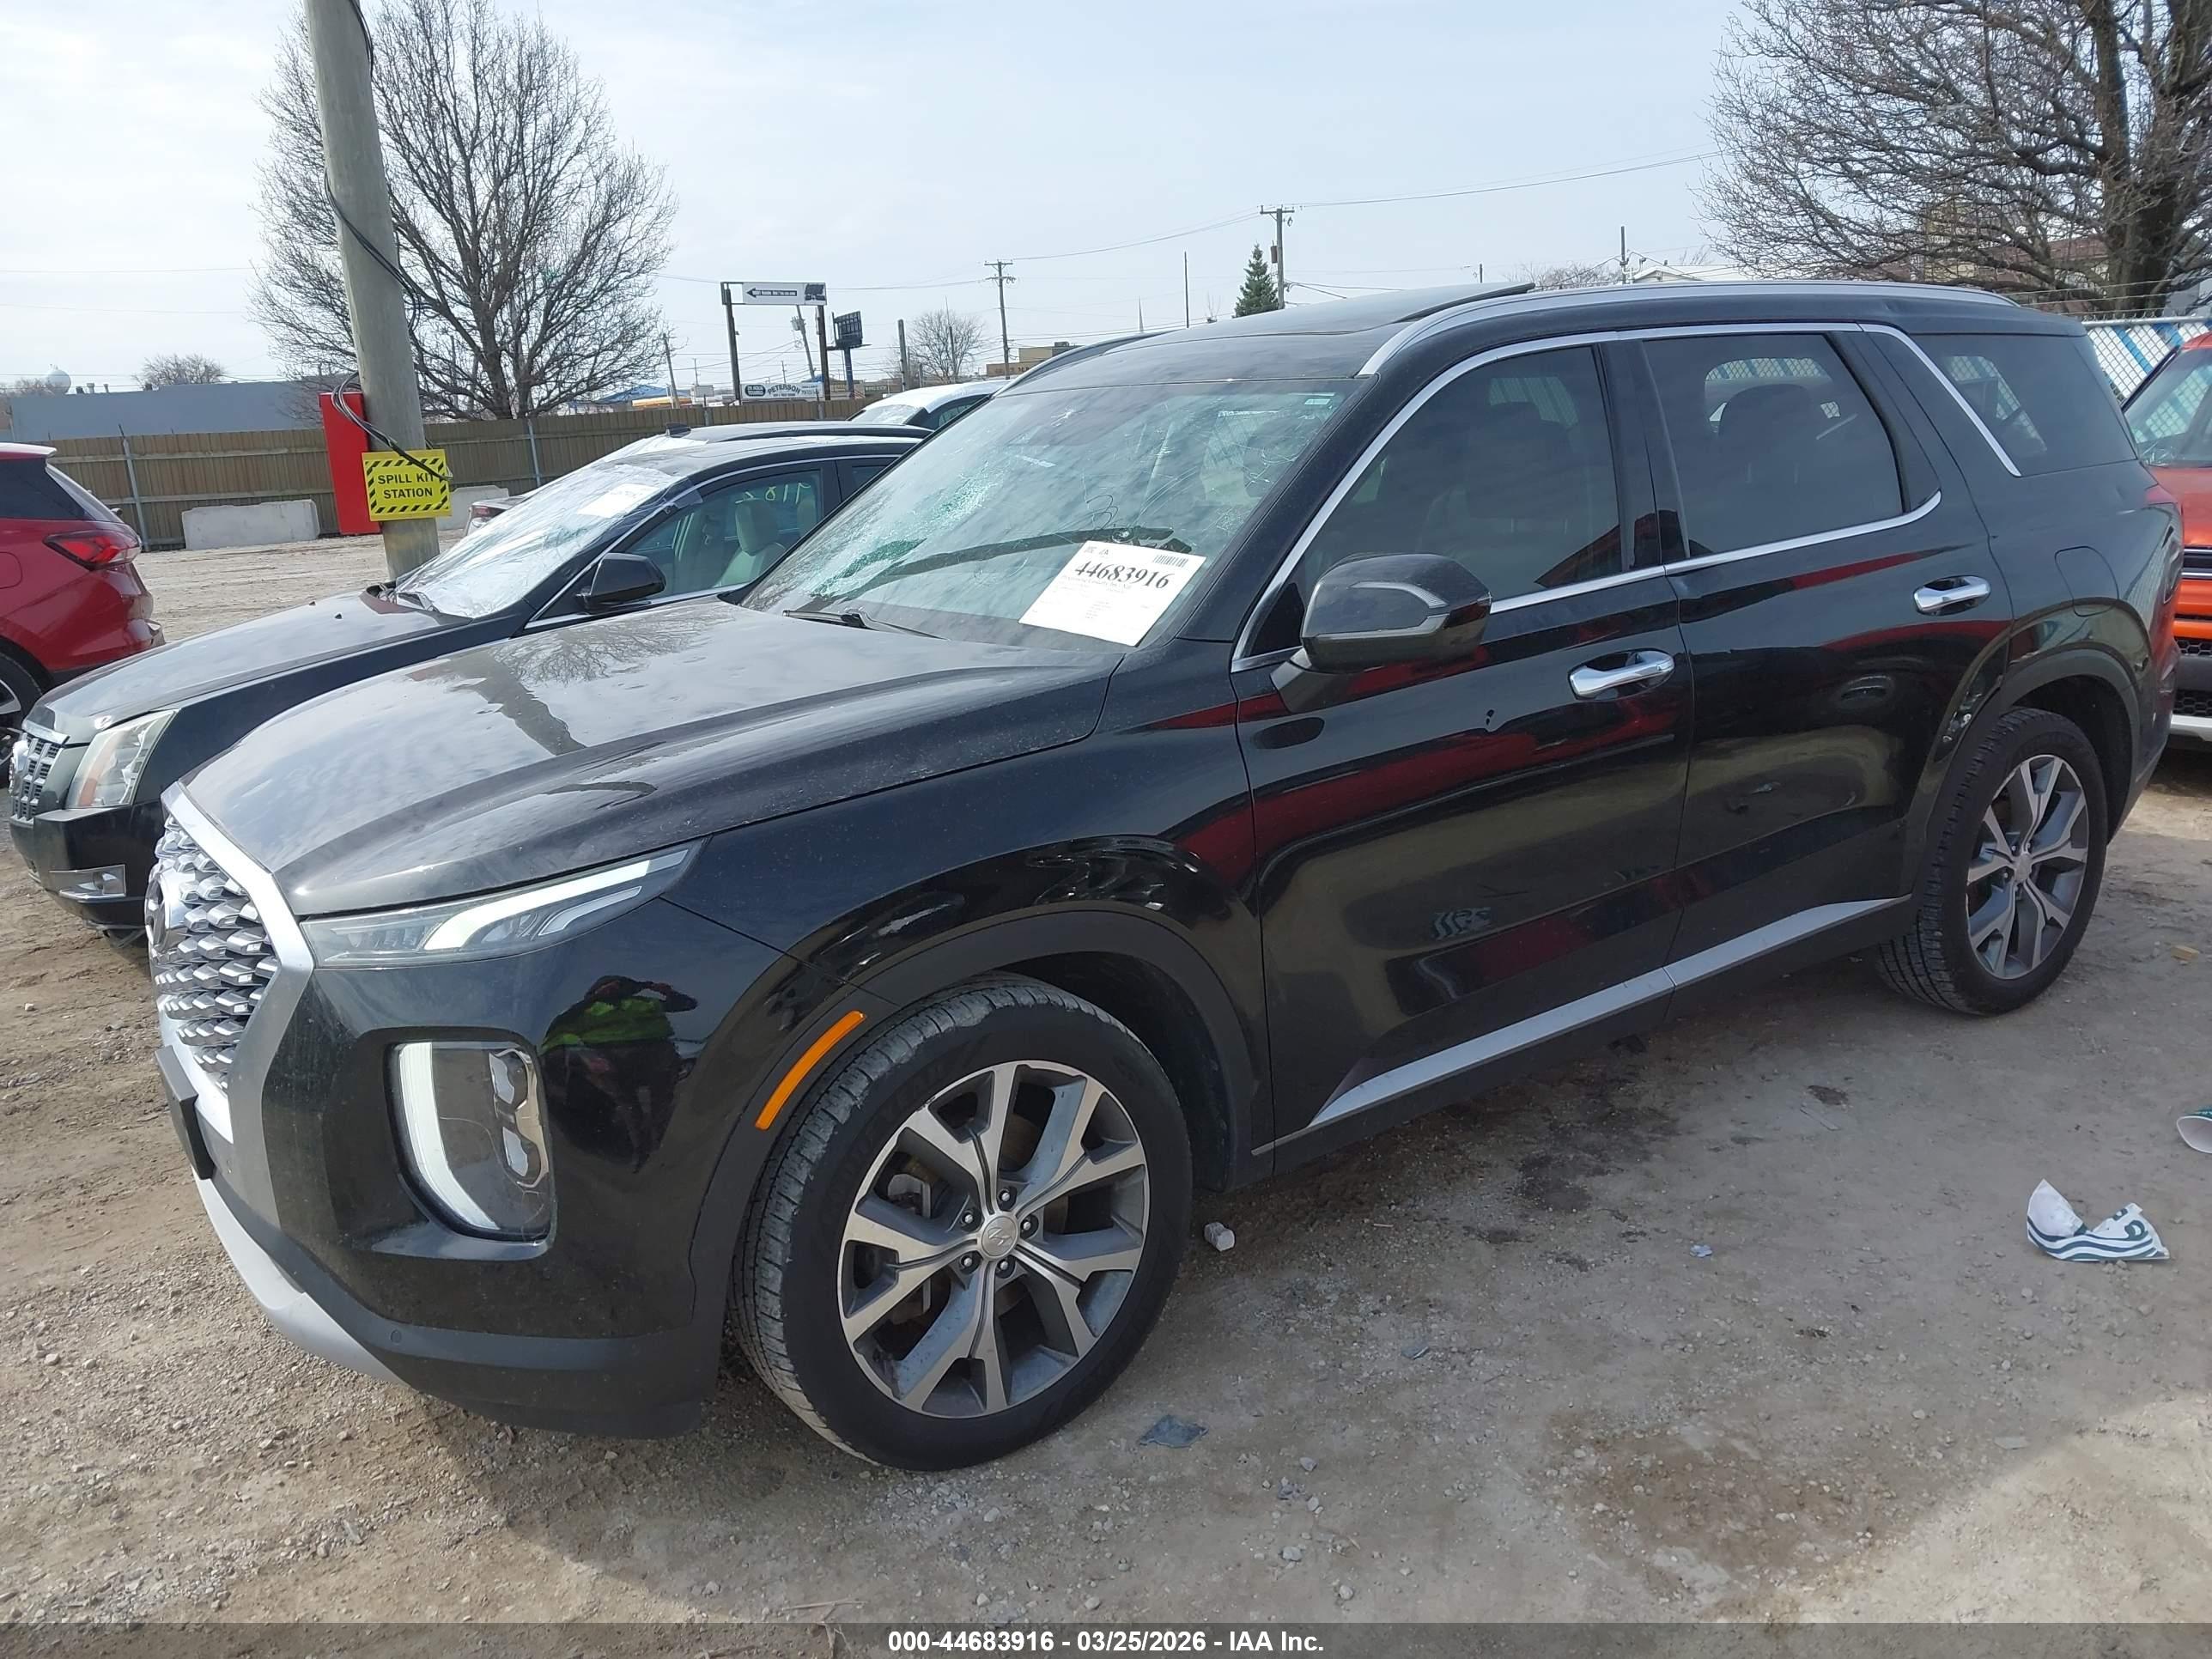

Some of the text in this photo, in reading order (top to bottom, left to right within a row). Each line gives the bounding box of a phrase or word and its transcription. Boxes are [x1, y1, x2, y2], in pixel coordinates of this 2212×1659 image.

[767, 384, 801, 394] PETERSON
[378, 472, 434, 484] SPILL KIT
[384, 488, 433, 499] STATION
[1074, 561, 1176, 589] 44683916
